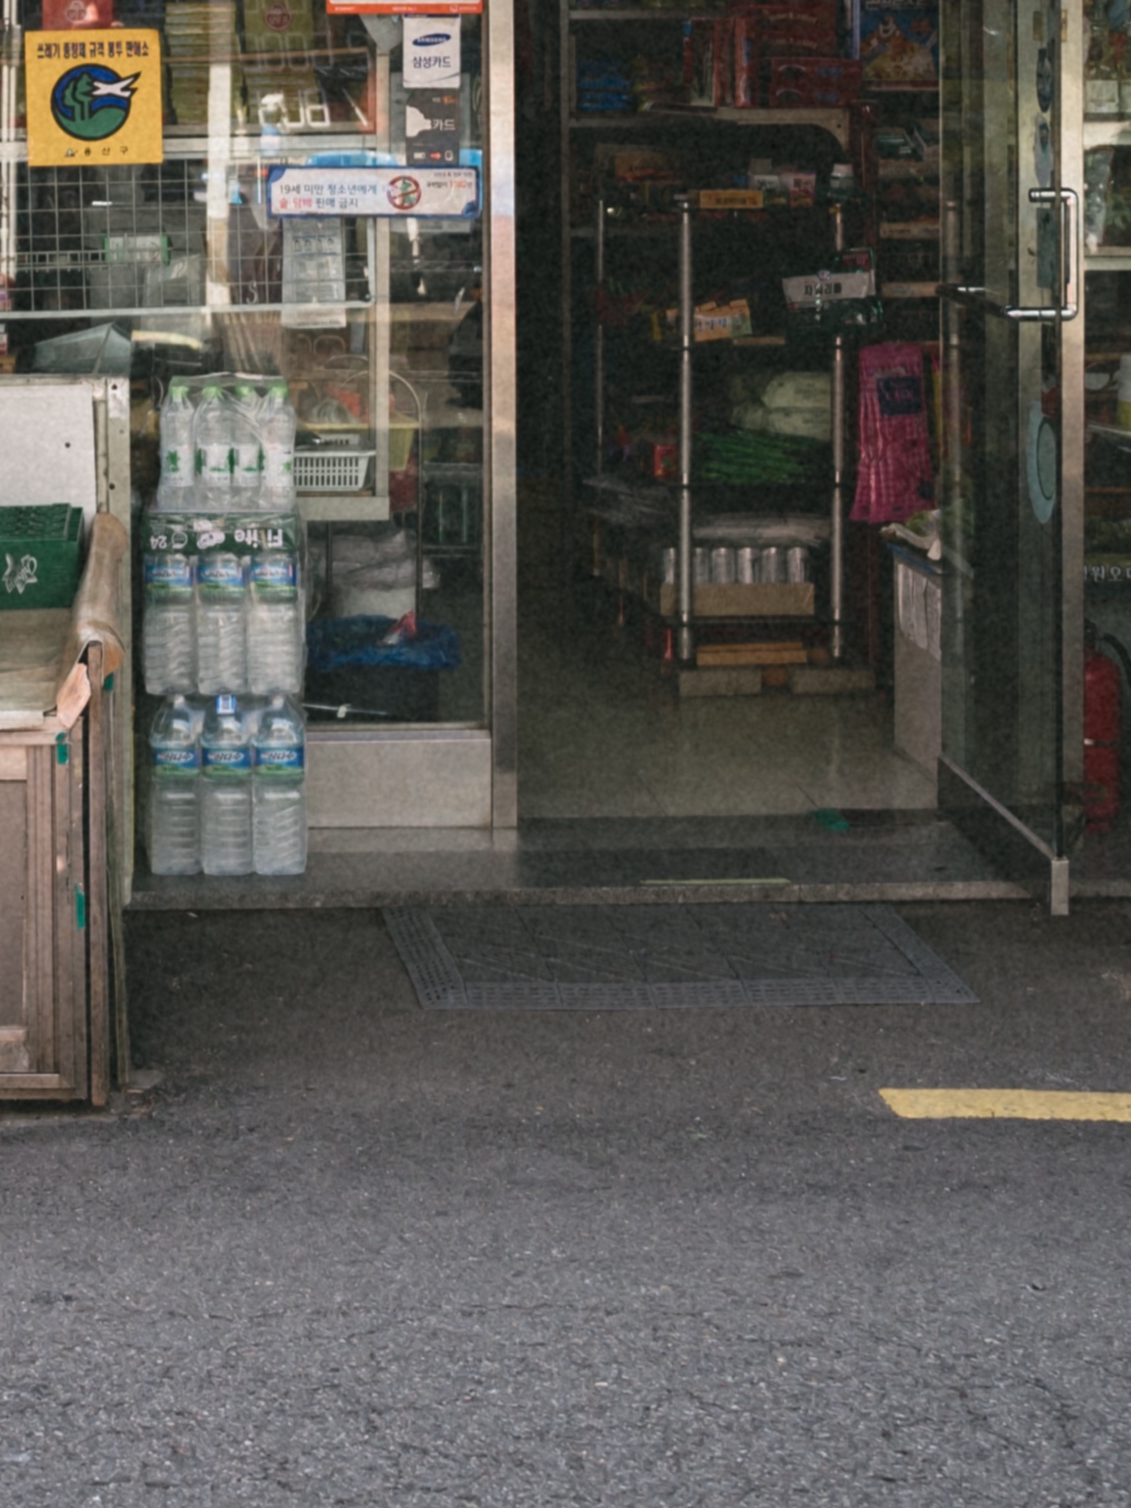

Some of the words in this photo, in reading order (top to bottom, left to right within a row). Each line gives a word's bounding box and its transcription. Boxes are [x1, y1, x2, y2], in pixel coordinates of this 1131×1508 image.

[37, 42, 61, 59] 쓰레기
[89, 41, 105, 58] 규격
[125, 40, 149, 57] 판매소
[412, 56, 451, 69] 삼성카드
[279, 184, 301, 195] 19세
[303, 184, 324, 195] 미만
[326, 184, 377, 195] 청소년에게
[315, 197, 335, 209] 판매
[338, 197, 359, 209] 금지
[149, 535, 167, 549] 24
